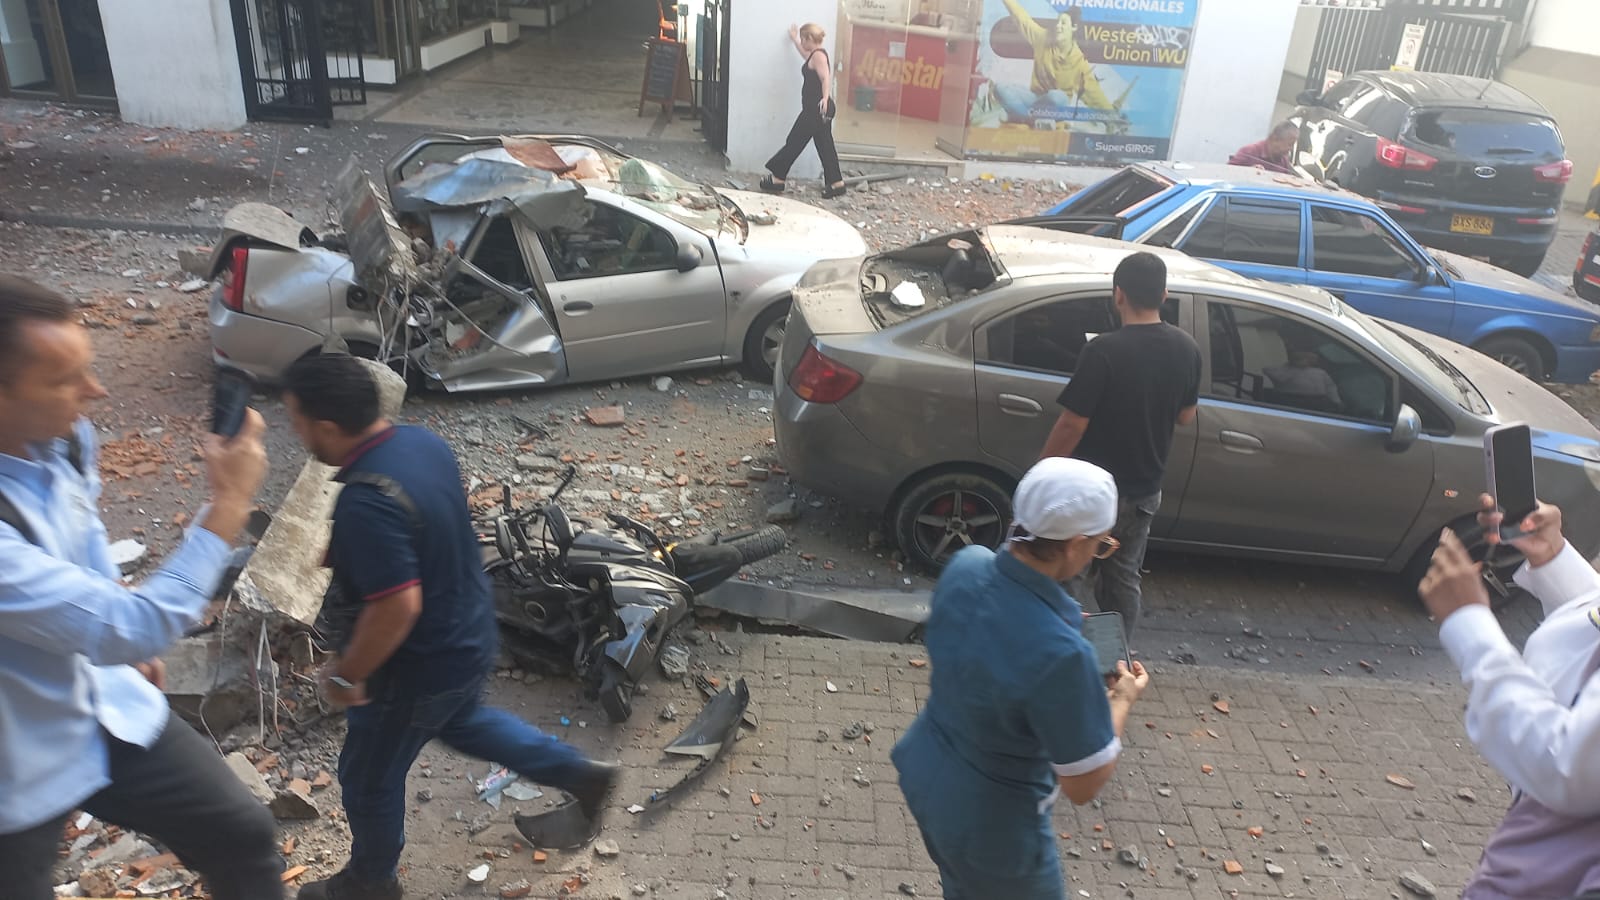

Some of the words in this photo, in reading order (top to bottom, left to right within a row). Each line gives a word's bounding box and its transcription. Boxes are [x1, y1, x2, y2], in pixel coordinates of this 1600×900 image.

[1103, 45, 1151, 63] Union
[1157, 47, 1186, 65] WU
[857, 49, 944, 90] Apostar
[1095, 141, 1156, 154] SuperGIROS
